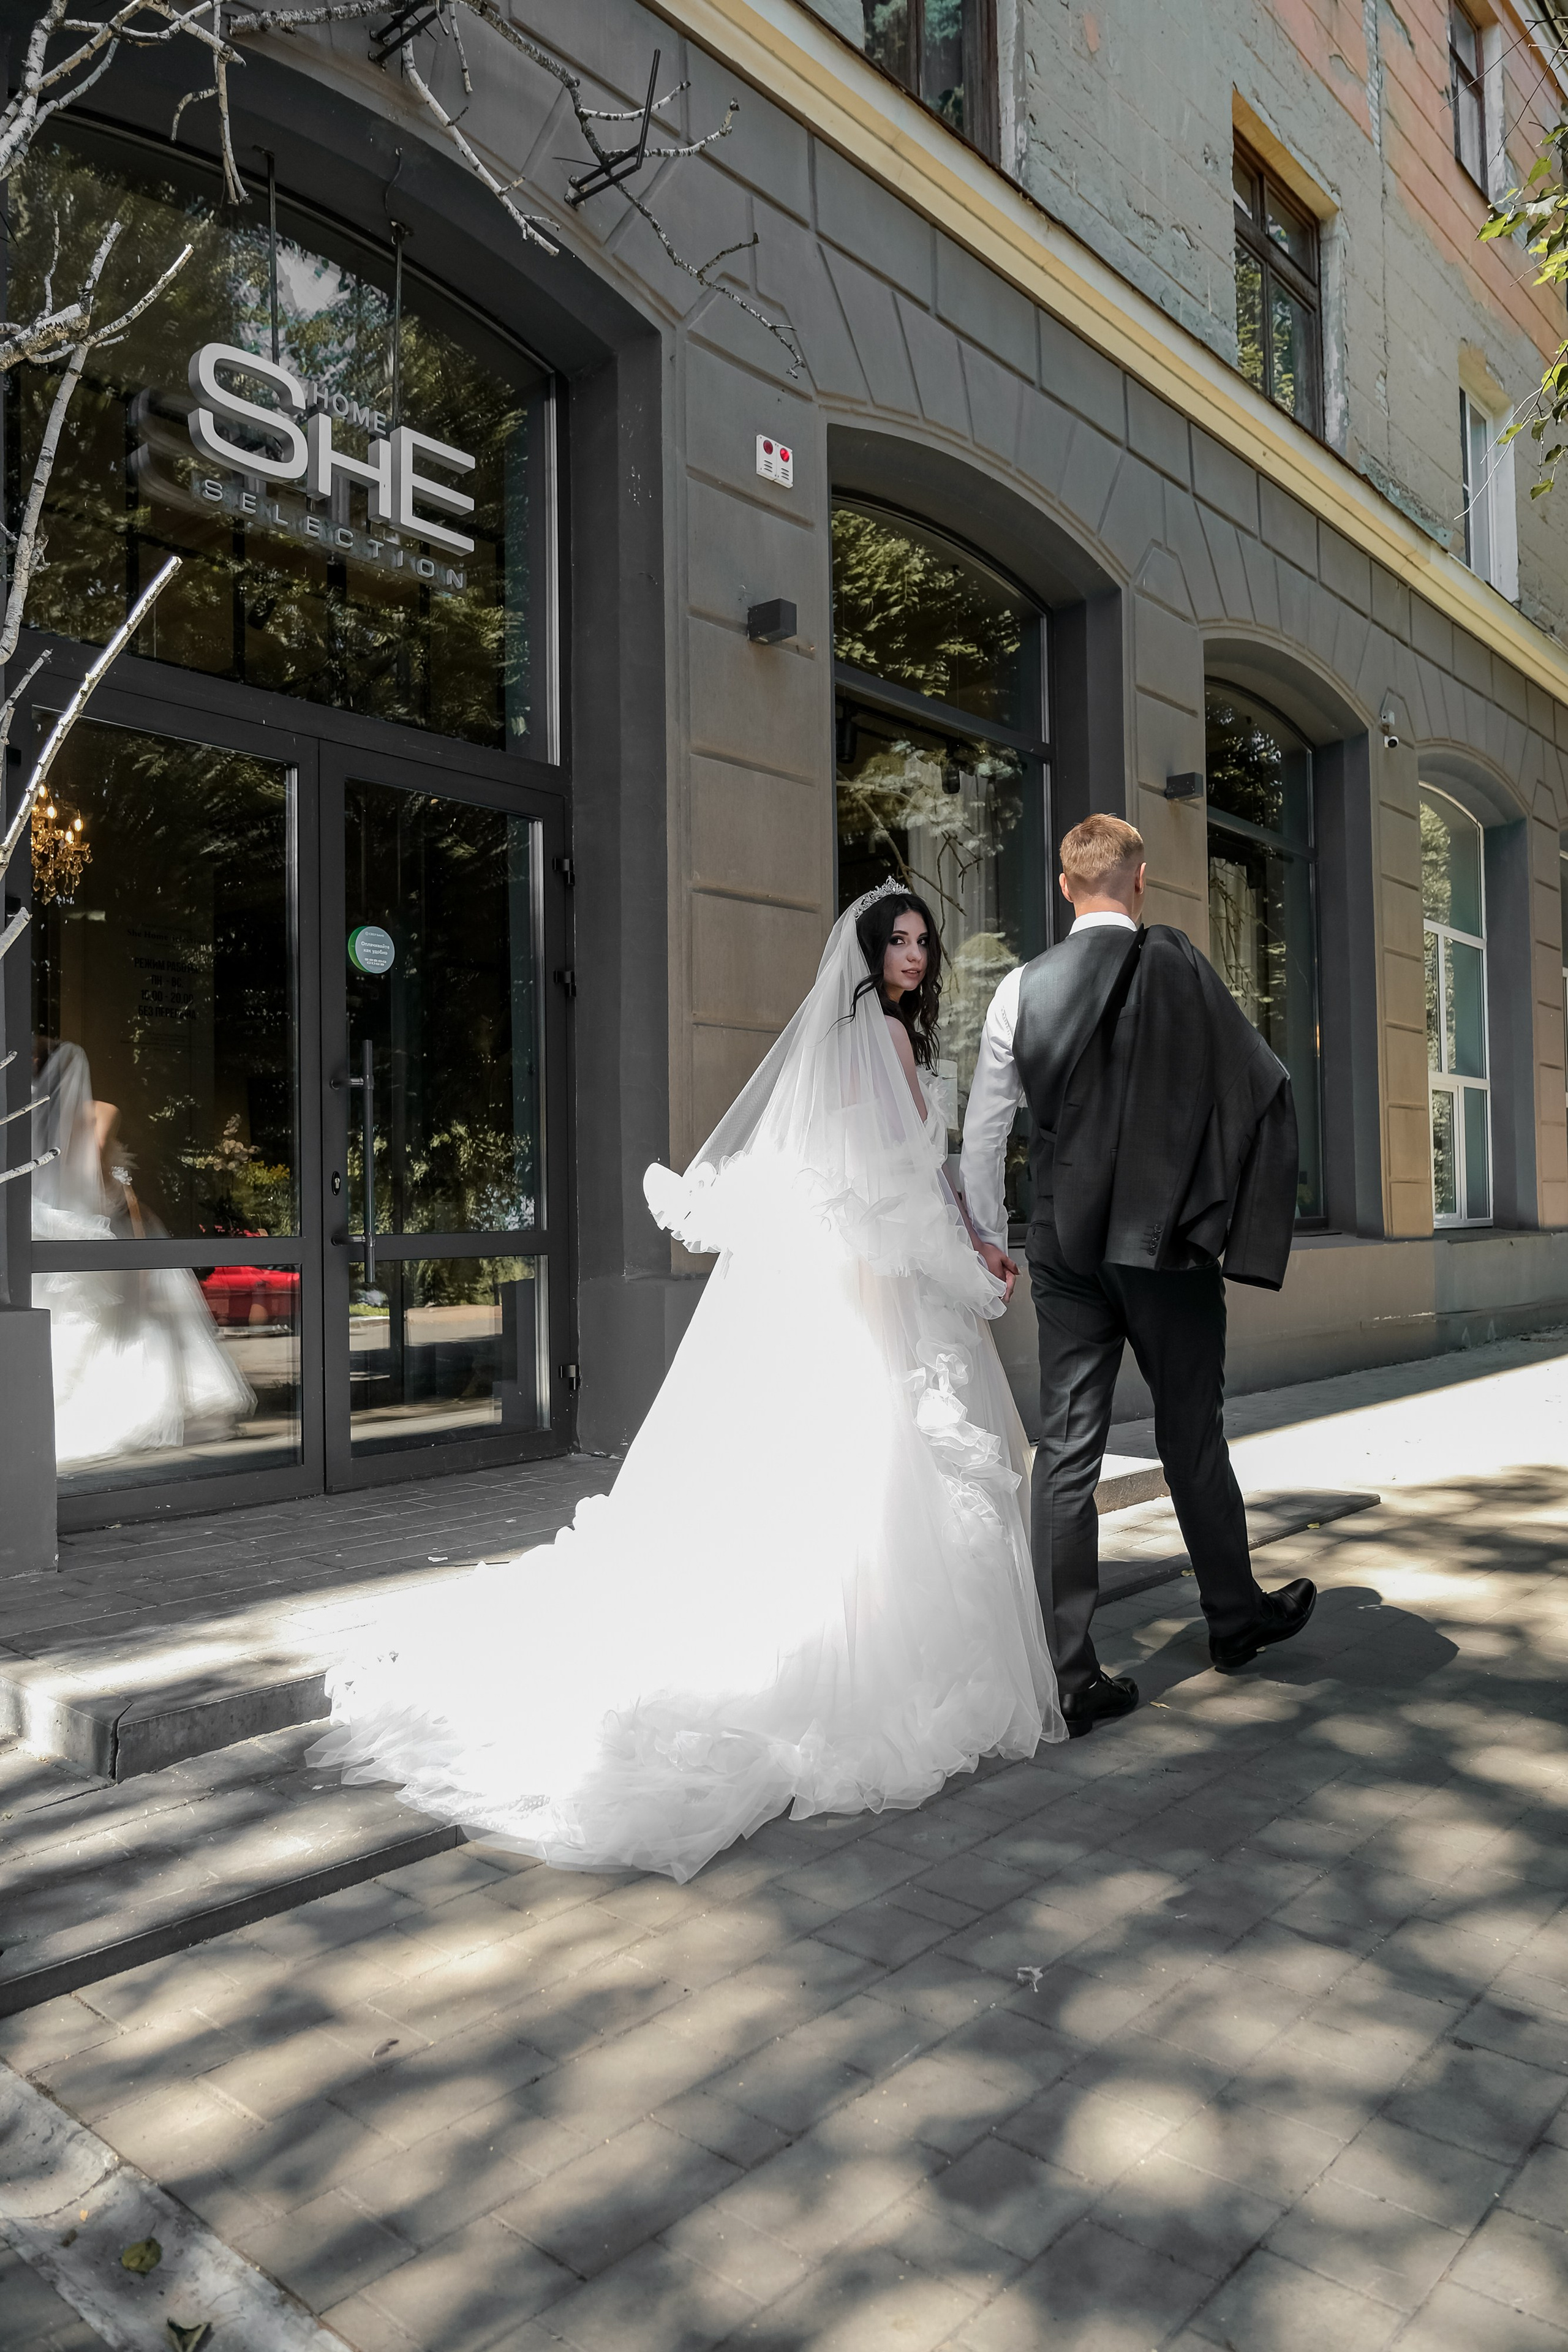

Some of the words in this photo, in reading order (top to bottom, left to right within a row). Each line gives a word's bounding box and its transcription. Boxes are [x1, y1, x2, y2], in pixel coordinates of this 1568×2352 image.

[308, 383, 386, 435] HOME
[188, 342, 475, 556] SHE
[202, 479, 465, 589] SELECTION
[127, 929, 141, 937] She
[144, 931, 168, 941] Home
[361, 941, 390, 949] Оплачивайте
[134, 957, 165, 970] РЕЖИМ
[151, 974, 162, 985] ПН
[172, 977, 184, 987] ВС.
[171, 992, 194, 1005] 20.00
[138, 1005, 153, 1016] БЕЗ
